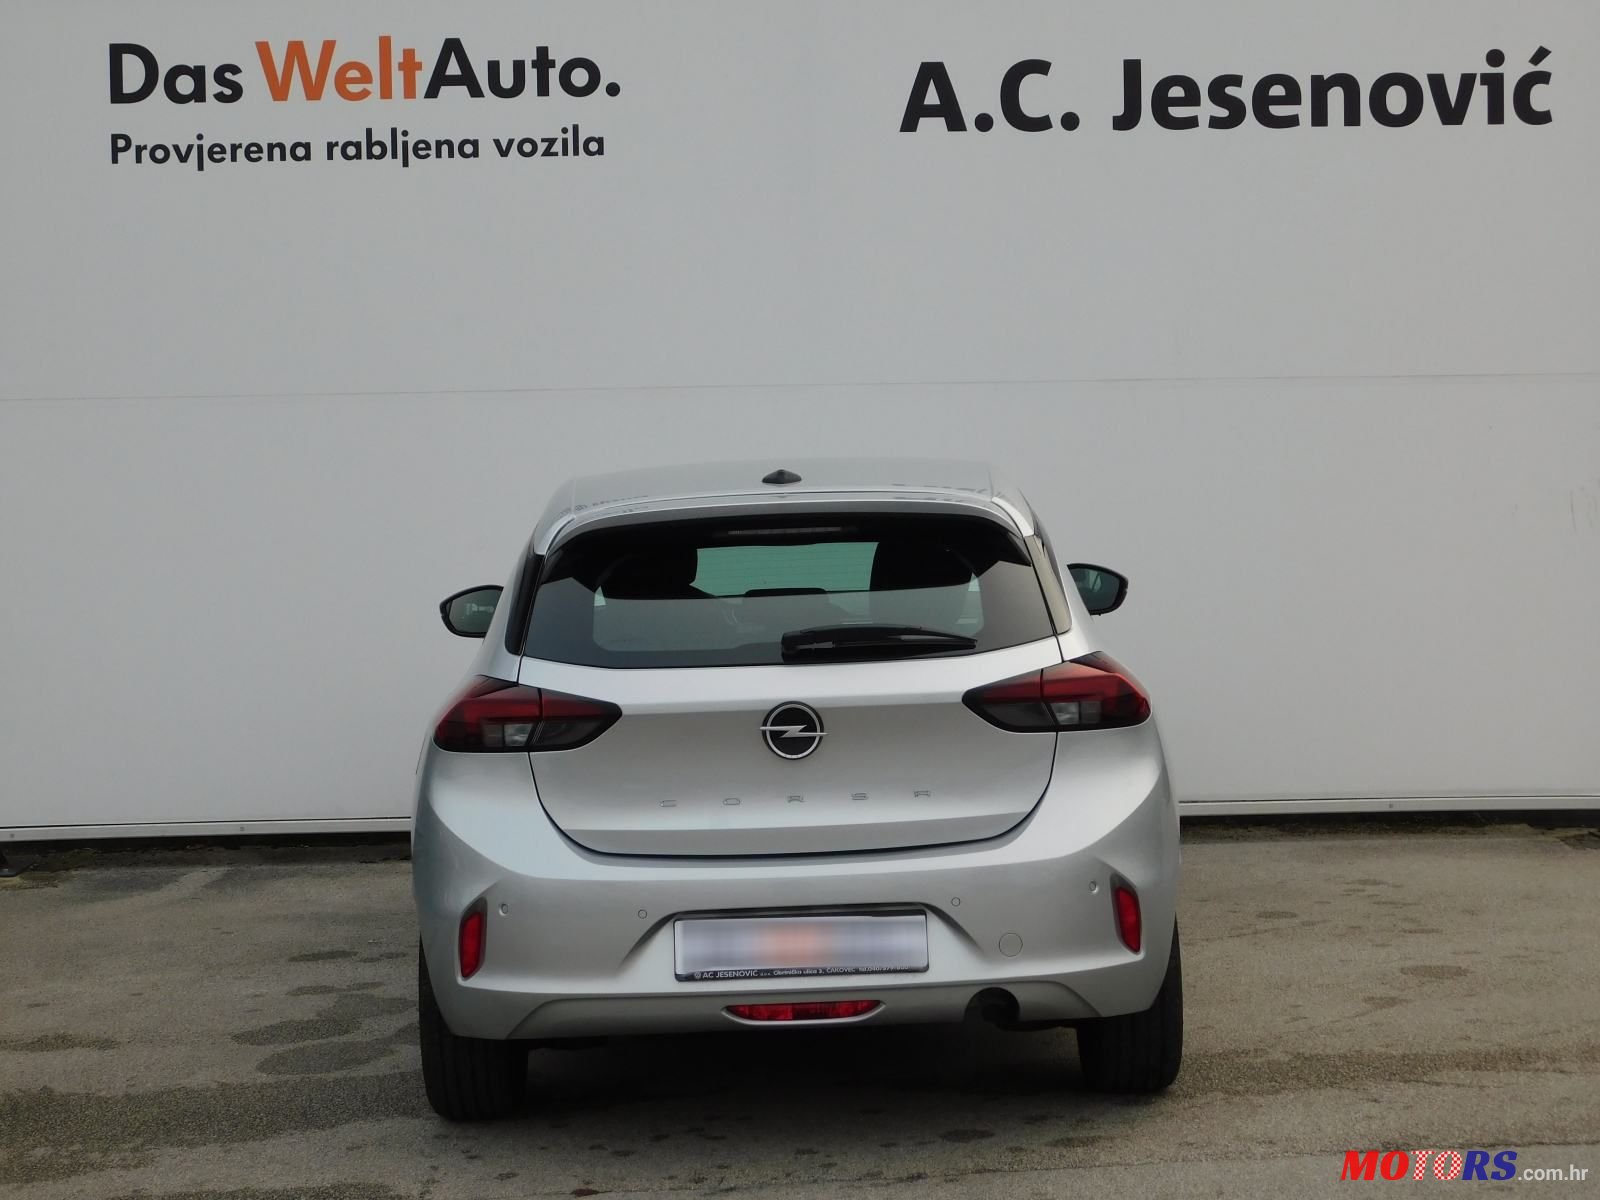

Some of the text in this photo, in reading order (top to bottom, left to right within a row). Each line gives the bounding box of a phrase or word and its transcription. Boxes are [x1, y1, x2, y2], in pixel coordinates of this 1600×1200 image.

[108, 36, 621, 105] Das WeltAuto.
[898, 46, 1553, 133] A.C. Jesenović
[110, 124, 605, 171] Provjerena rabljena vozila
[660, 789, 932, 808] CORSA
